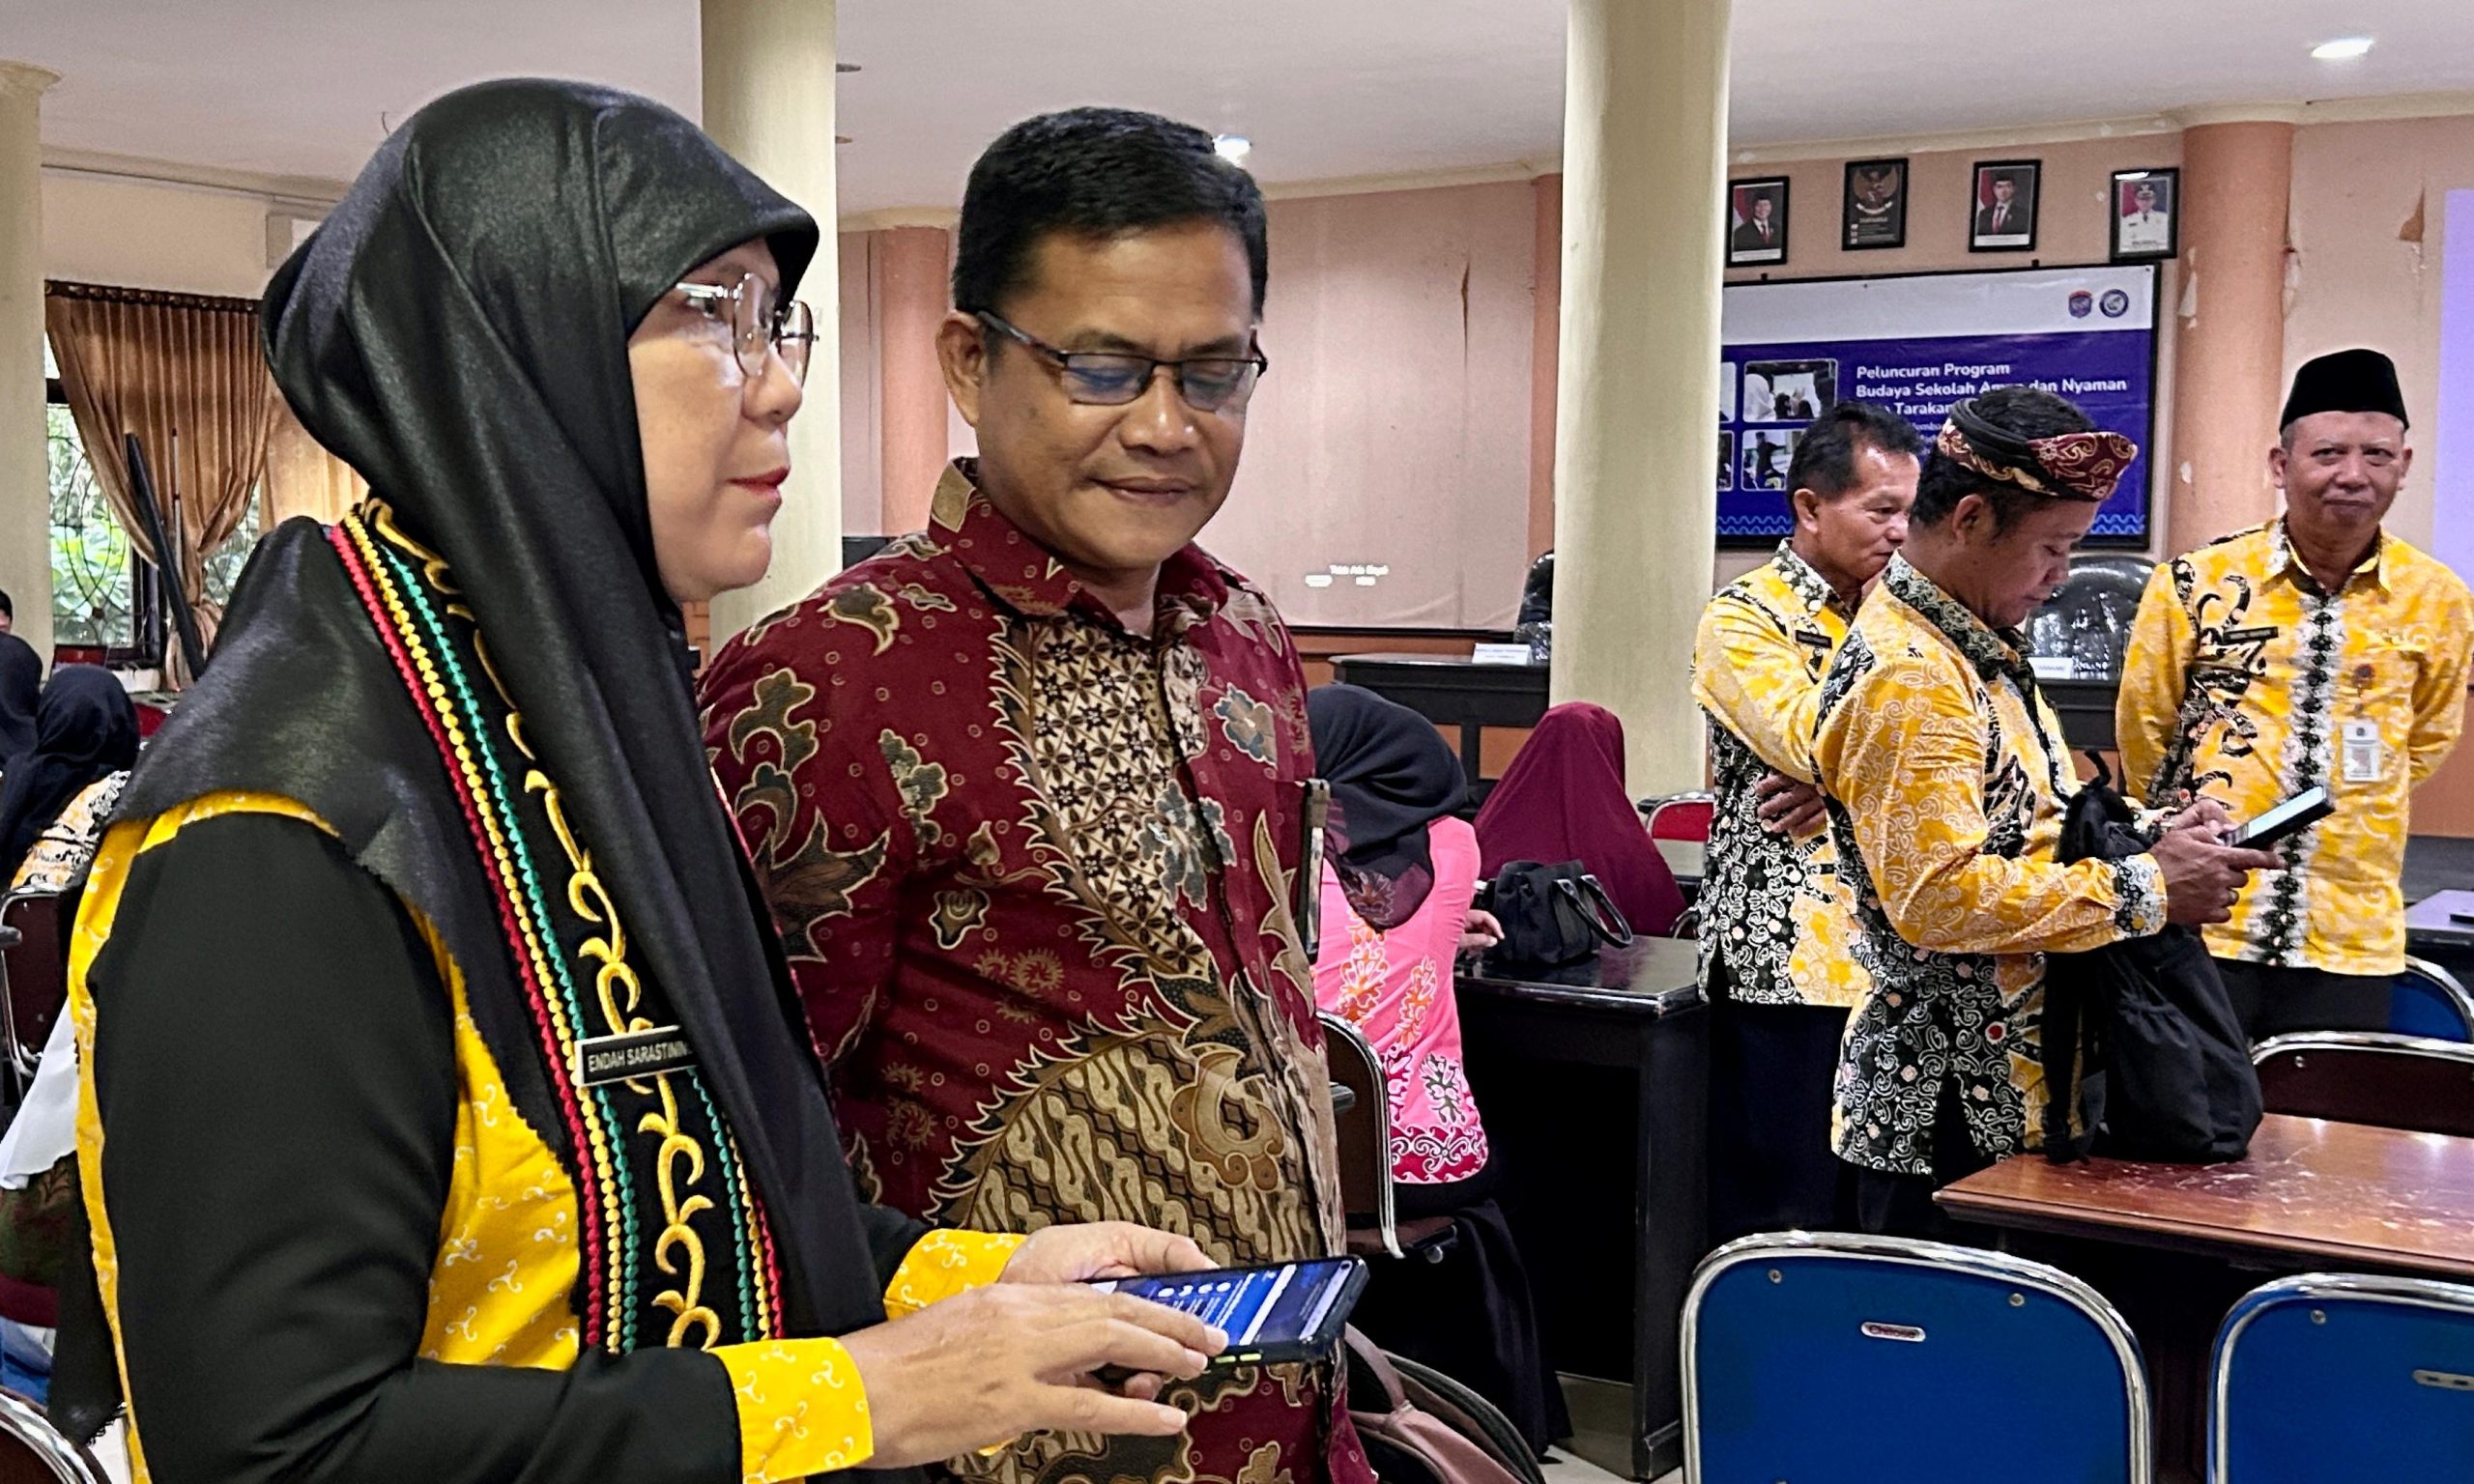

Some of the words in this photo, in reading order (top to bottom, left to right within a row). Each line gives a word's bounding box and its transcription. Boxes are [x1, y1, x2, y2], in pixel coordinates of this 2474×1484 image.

[1856, 366, 1940, 379] Peluncuran
[1944, 363, 2010, 378] Program
[1856, 385, 1911, 399] Budaya
[1915, 383, 1974, 396] Sekolah
[2062, 378, 2126, 393] Nyaman
[588, 1050, 625, 1072] ENDAH
